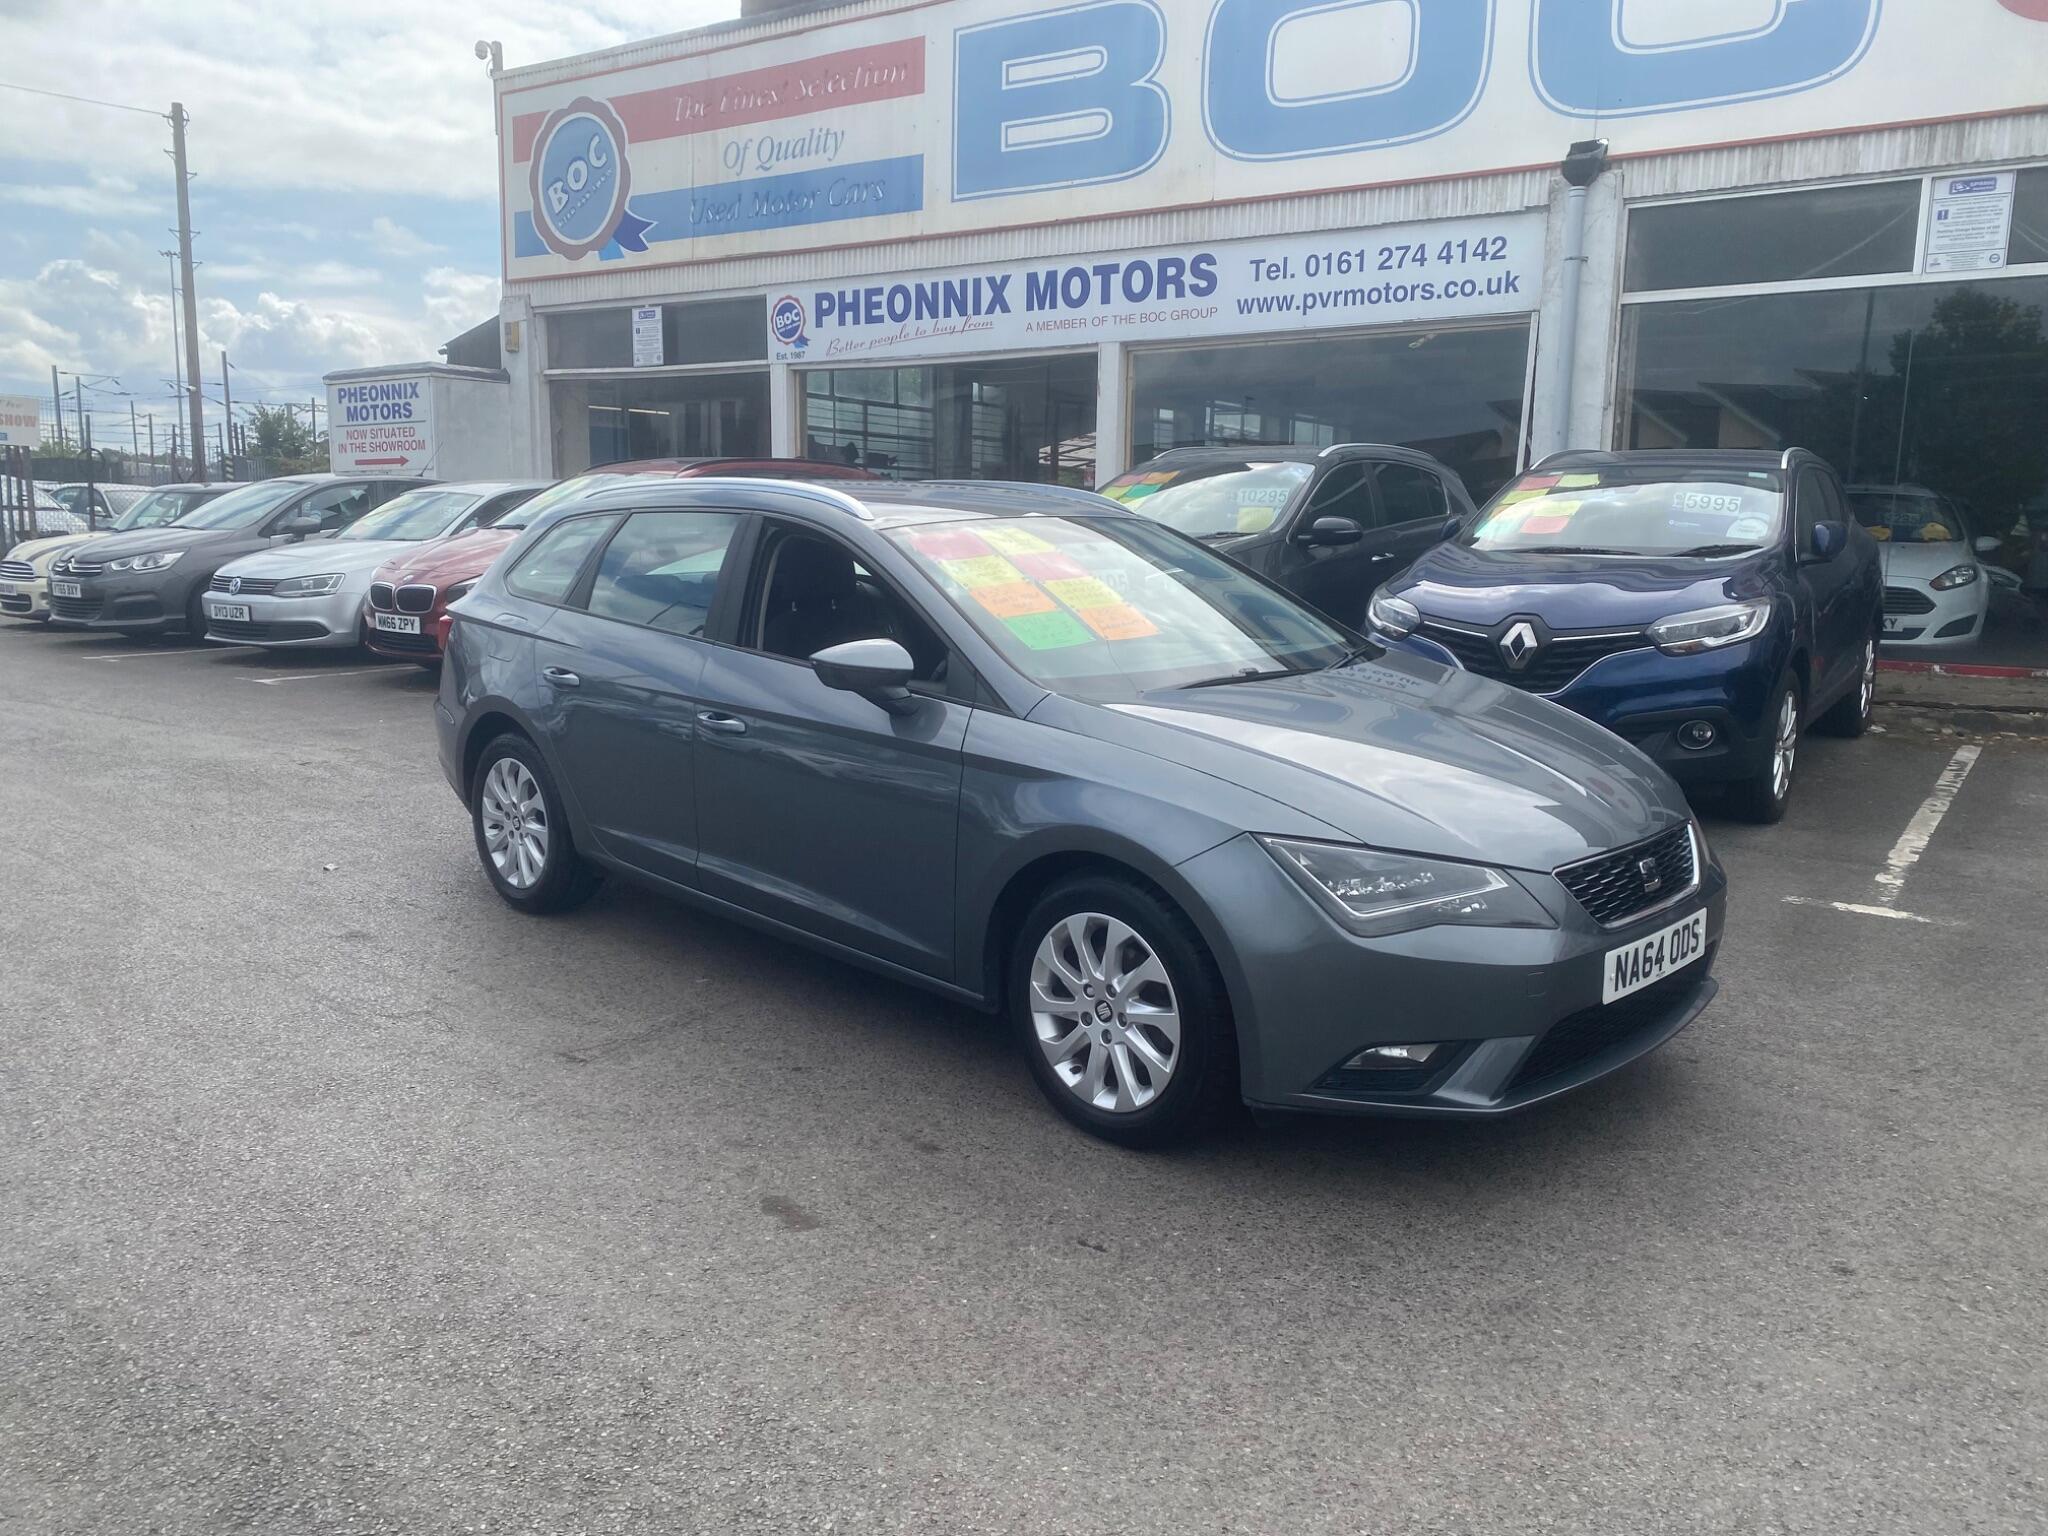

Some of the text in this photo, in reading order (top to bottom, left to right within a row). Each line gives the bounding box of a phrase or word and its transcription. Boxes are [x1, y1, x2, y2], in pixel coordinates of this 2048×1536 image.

[674, 95, 713, 122] The
[793, 62, 909, 101] Selection
[722, 127, 845, 176] Of Quality
[547, 134, 608, 214] BOC
[688, 177, 887, 225] Used Motor Cars
[1249, 235, 1508, 282] Tel. 0161 274 4142
[814, 253, 1218, 328] PHEONNIX MOTORS
[1236, 270, 1521, 316] www.pvrmotors.co.uk
[776, 308, 800, 329] BOC
[826, 314, 993, 358] Better people to buy from
[1025, 306, 1218, 333] A MEMBER OF THE BOC GROUP
[776, 352, 789, 361] Est.
[337, 382, 420, 404] PHEONNIX
[346, 401, 413, 423] MOTORS
[338, 439, 426, 454] IN THE SHOWROOM
[346, 426, 416, 441] NOW SITUATED
[229, 607, 244, 619] UZR
[397, 617, 415, 631] ZPY
[1615, 918, 1700, 992] NA64 ODS
